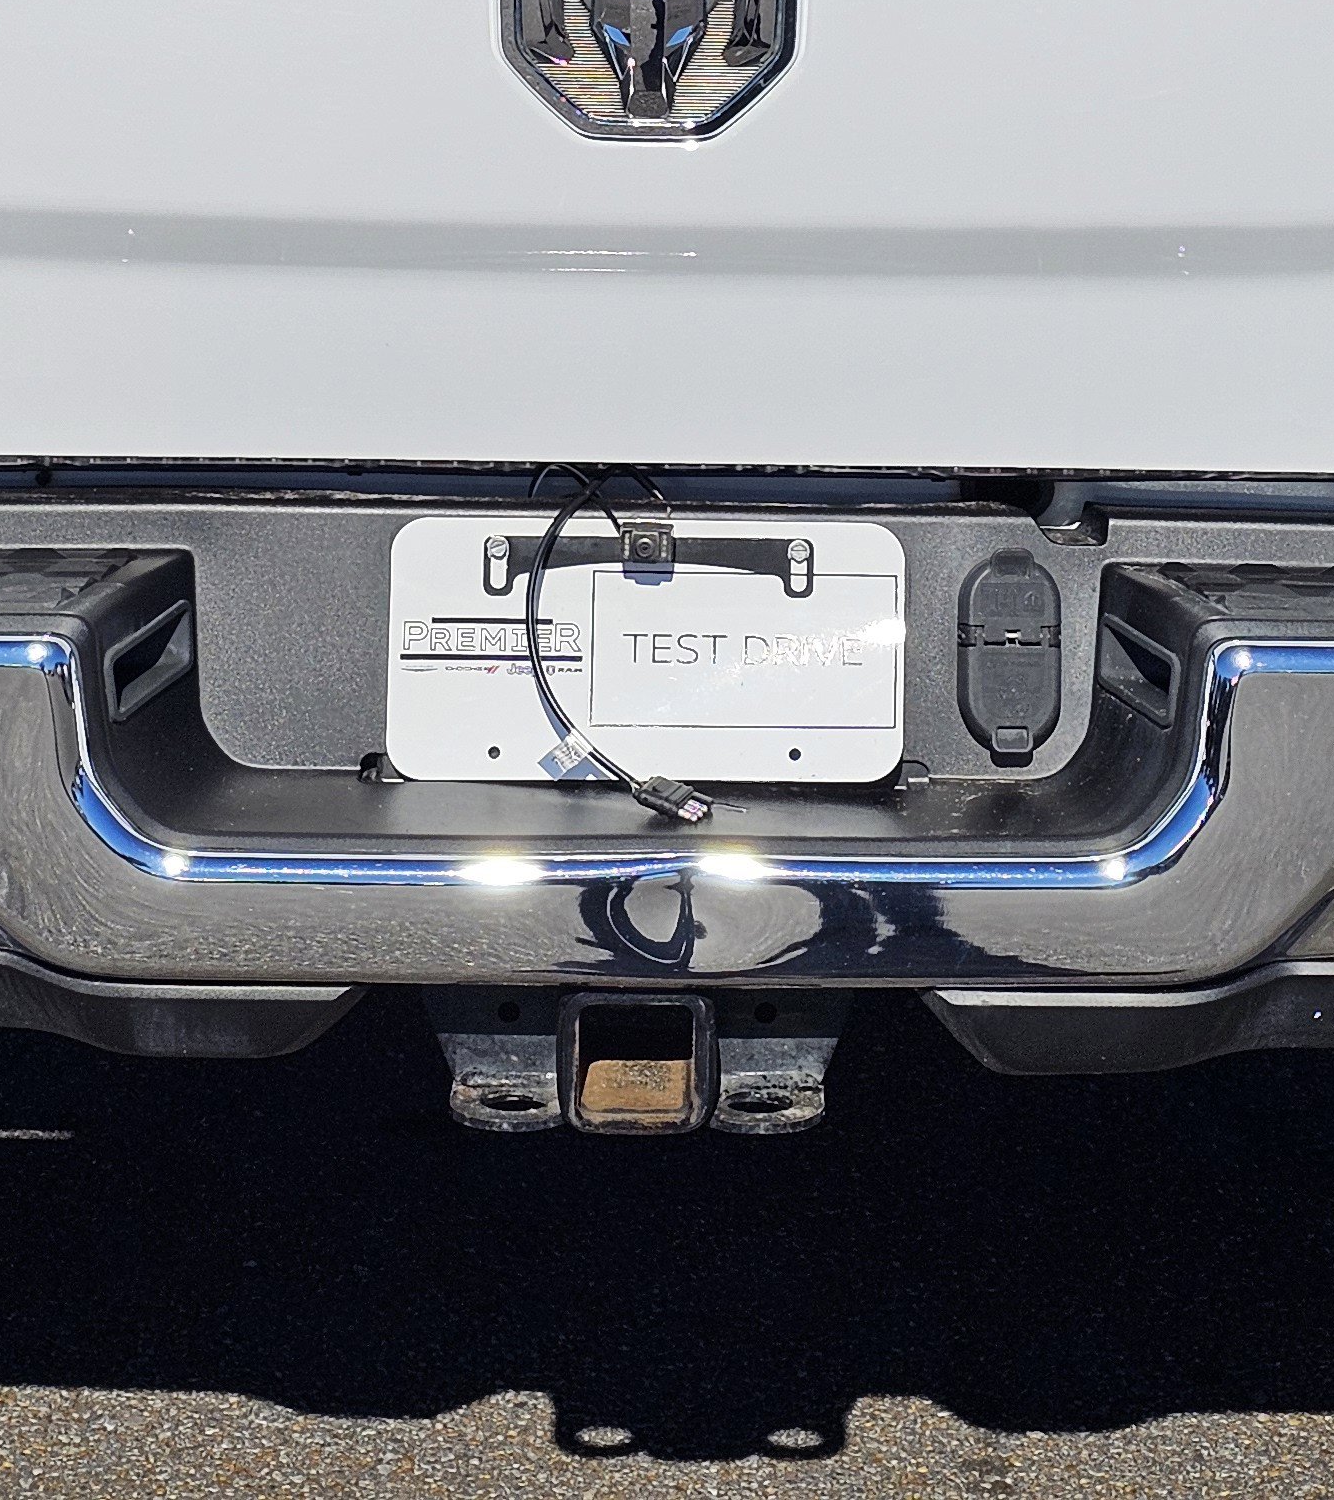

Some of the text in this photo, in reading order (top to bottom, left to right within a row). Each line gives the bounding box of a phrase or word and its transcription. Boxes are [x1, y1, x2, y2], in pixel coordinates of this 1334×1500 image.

[402, 620, 583, 653] PREMIER
[622, 633, 864, 667] TEST DRIVE
